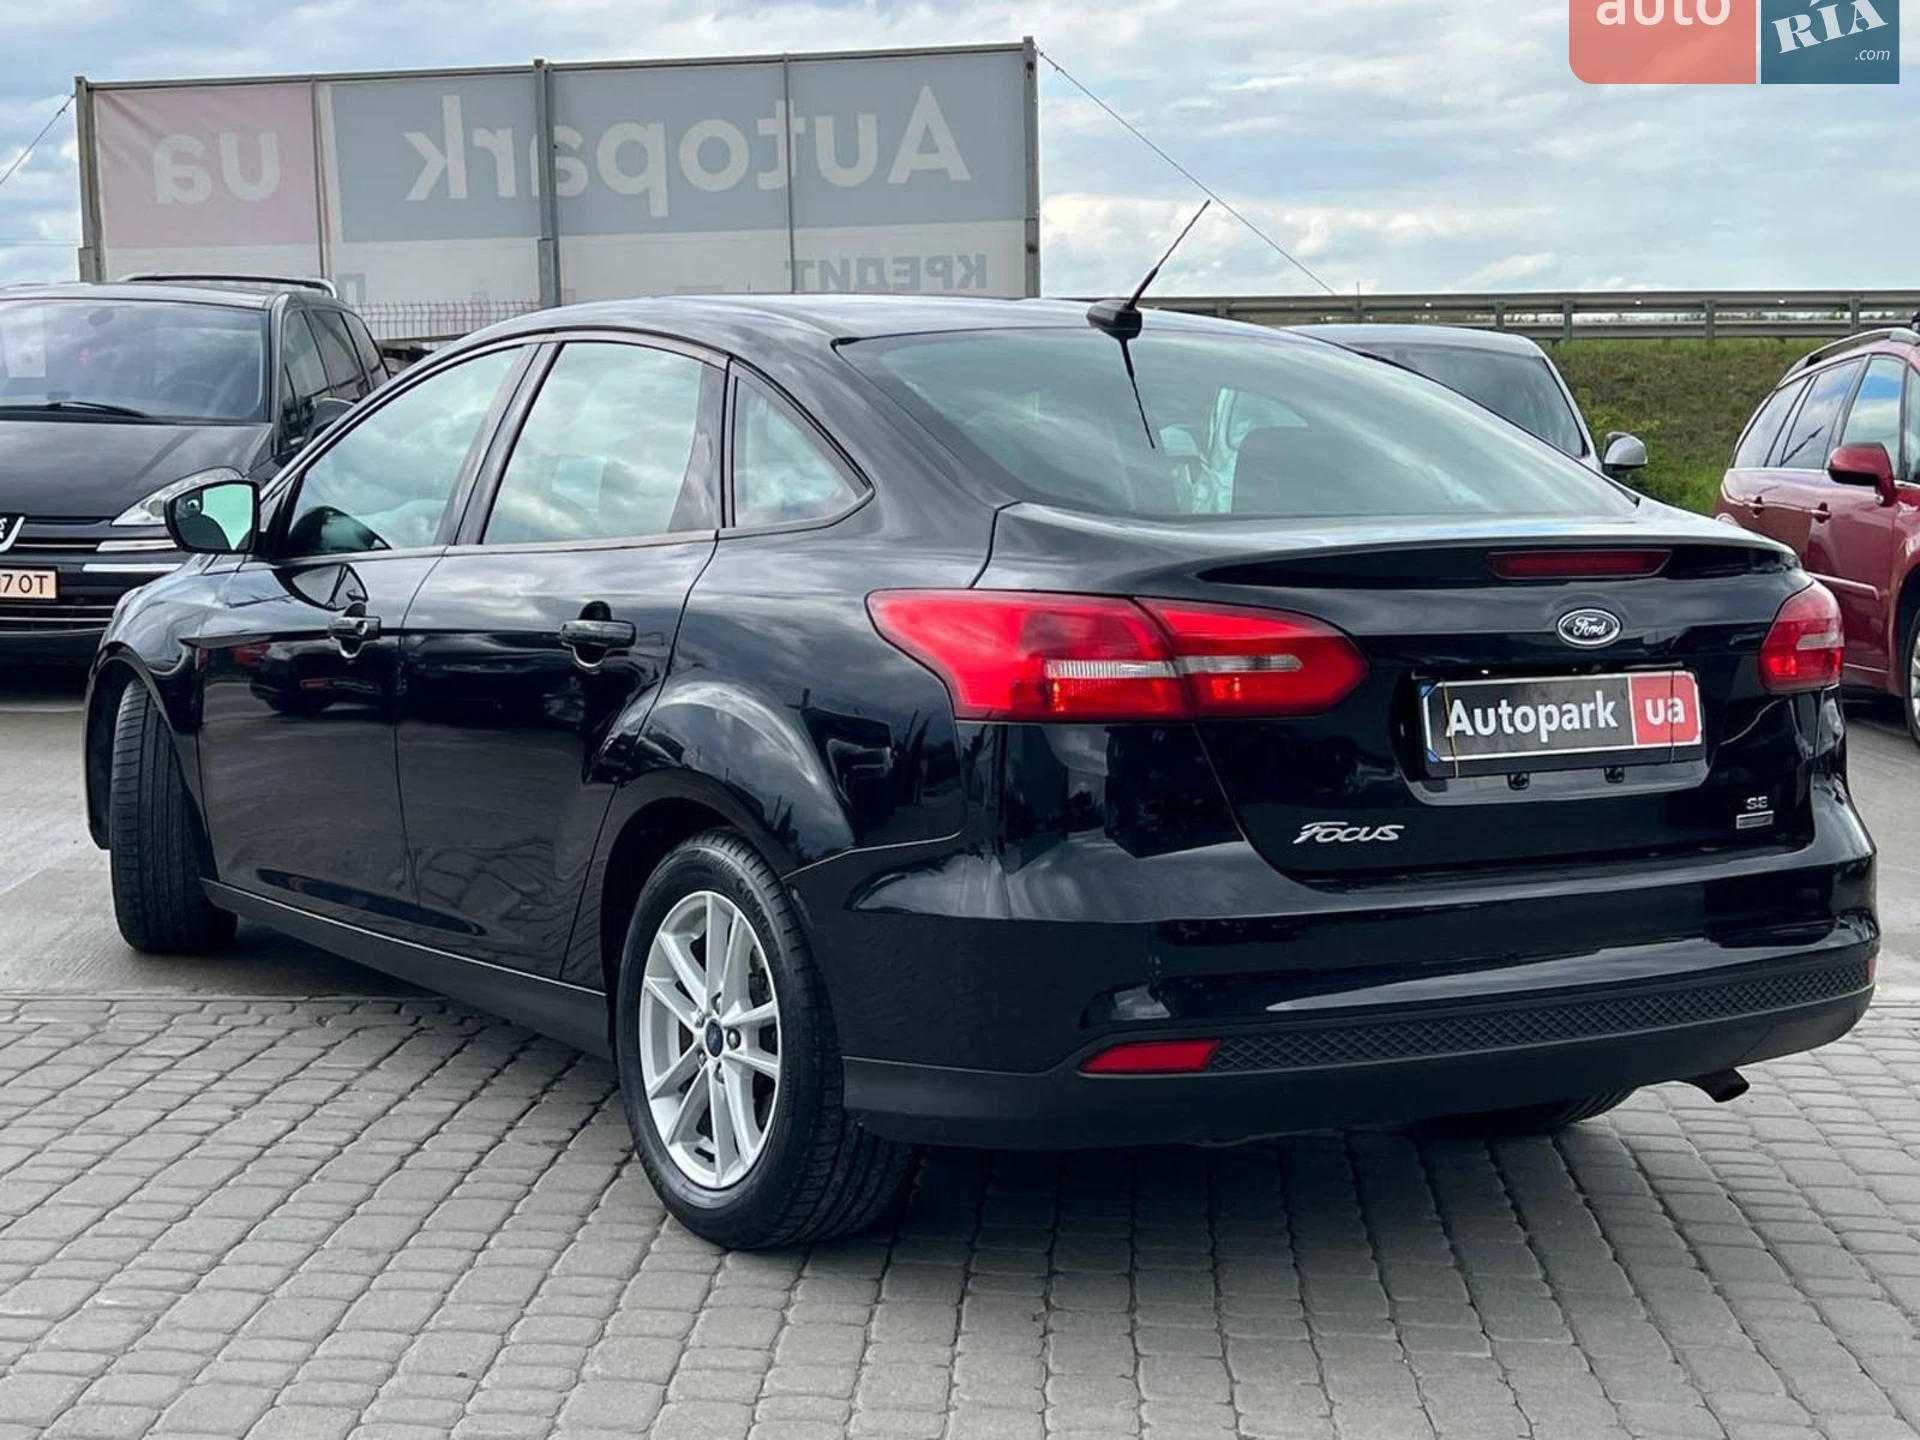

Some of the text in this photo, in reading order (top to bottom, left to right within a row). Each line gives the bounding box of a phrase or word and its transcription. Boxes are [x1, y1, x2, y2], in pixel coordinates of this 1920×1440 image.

[1573, 616, 1606, 636] Ford
[1446, 691, 1686, 743] Autopark ua
[1746, 796, 1768, 810] SE
